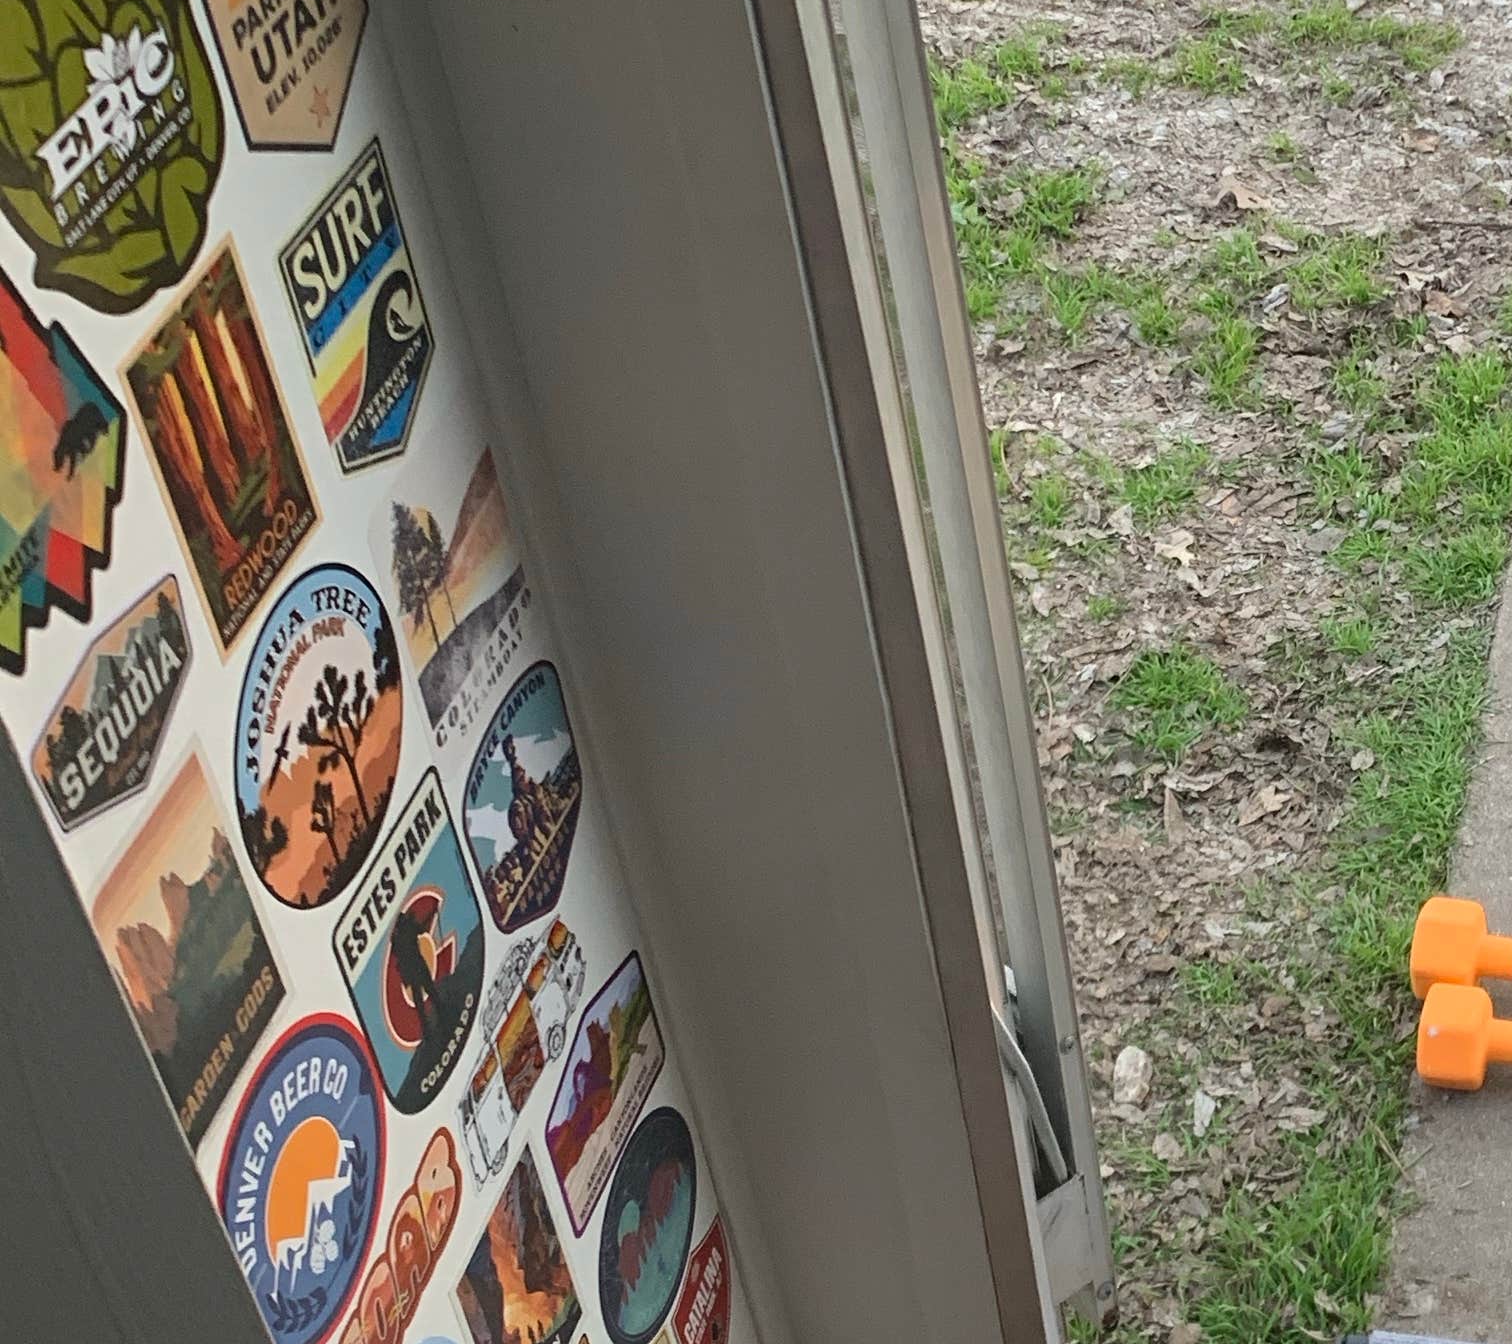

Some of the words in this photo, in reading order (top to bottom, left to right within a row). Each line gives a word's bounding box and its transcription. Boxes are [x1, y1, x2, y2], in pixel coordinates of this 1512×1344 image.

[54, 78, 186, 227] BREWING
[64, 218, 87, 248] SALT
[84, 195, 109, 227] LAKE
[105, 176, 129, 203] CITY
[293, 157, 384, 321] SURF
[348, 336, 422, 442] HUNTINGTON
[222, 588, 258, 640] NATIONAL
[257, 563, 274, 588] AND
[223, 499, 298, 610] REDWOOD
[64, 637, 183, 812] SEQUOIA
[245, 607, 306, 783] JOSHUA
[310, 584, 372, 631] TREE
[264, 633, 311, 736] NATIONAL
[310, 616, 347, 646] PARK
[435, 587, 532, 748] COLORADO
[470, 728, 500, 804] BRYCE
[500, 671, 547, 731] CANYON
[342, 866, 397, 971] ESTES
[394, 787, 442, 881] PARK
[179, 1032, 235, 1133] GARDEN
[235, 965, 274, 1033] GODS
[421, 992, 474, 1093] COLORADO
[234, 1121, 274, 1278] DENVER
[269, 1056, 322, 1127] BEER
